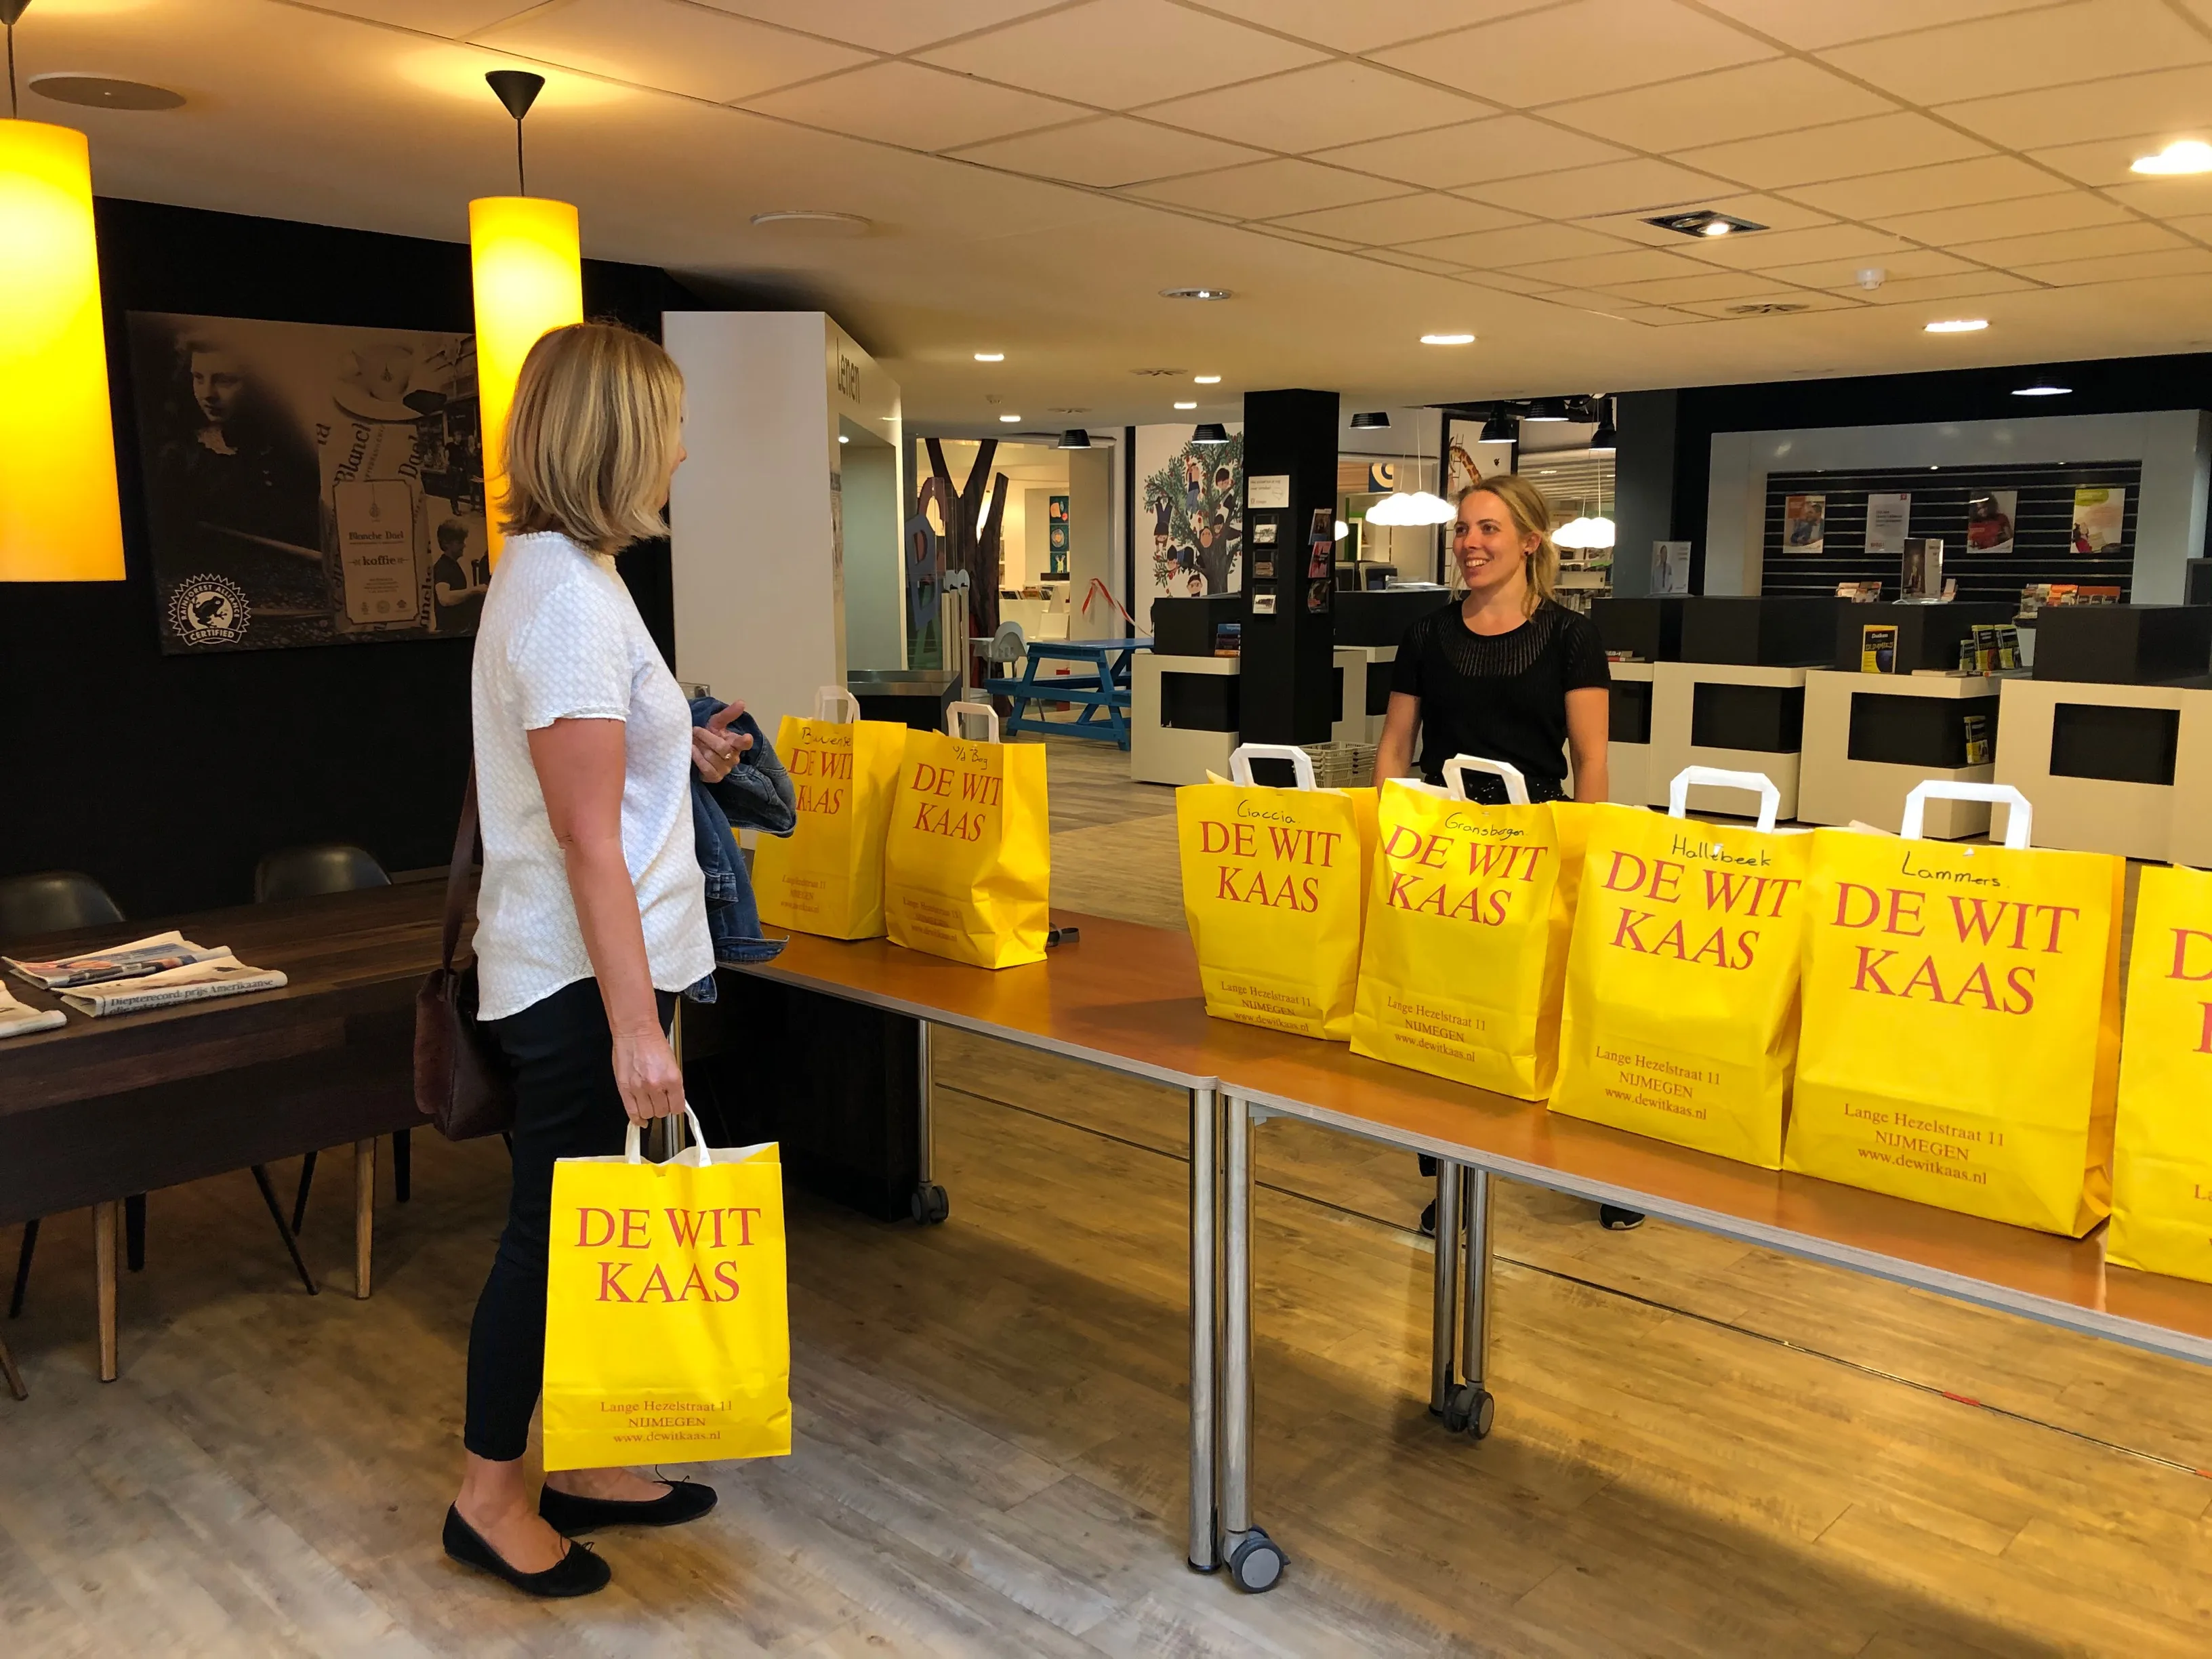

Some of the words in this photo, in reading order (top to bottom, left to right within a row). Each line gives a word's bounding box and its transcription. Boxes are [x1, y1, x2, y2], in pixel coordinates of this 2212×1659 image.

[836, 337, 860, 405] Lenen
[334, 422, 372, 483] Blanc
[363, 555, 396, 566] koffie
[180, 584, 212, 620] RAINFOREST
[216, 586, 240, 618] ALLIANCE
[190, 629, 234, 640] CERTIFIED
[788, 747, 816, 776] DE
[910, 762, 955, 797] DE
[962, 773, 1003, 806] WIT
[913, 802, 987, 842] KAAS
[1198, 821, 1258, 858] DE
[1267, 826, 1342, 868] WIT
[1385, 823, 1454, 869] DE
[1469, 842, 1549, 882] WIT
[1215, 865, 1319, 914] KAAS
[1386, 871, 1512, 927] KAAS
[1601, 851, 1685, 903] DE
[1702, 869, 1802, 918] WIT
[1830, 881, 1927, 938] DE
[1948, 895, 2080, 954] WIT
[1609, 907, 1760, 970] KAAS
[184, 986, 209, 999] prijs
[211, 978, 274, 994] Amerikaanse
[1221, 981, 1248, 996] Lange
[1249, 985, 1300, 1006] Hezelstraat
[1301, 998, 1311, 1007] 11
[1849, 945, 2036, 1015] KAAS
[1242, 1000, 1296, 1017] NIJMEGEN
[1387, 996, 1413, 1015] Lange
[1416, 1004, 1472, 1027] Hezelstraat
[1475, 1019, 1486, 1031] 11
[1394, 1031, 1475, 1063] www.dewitkaas.nl
[1404, 1019, 1465, 1043] NIJMEGEN
[1595, 1046, 1632, 1067] Lange
[1635, 1053, 1703, 1082] Hezelstraat
[1706, 1071, 1721, 1086] 11
[1618, 1071, 1694, 1100] NIJMEGEN
[1605, 1087, 1707, 1121] www.dewitkaas.nl
[1843, 1103, 1889, 1127] Lange
[1894, 1111, 1982, 1143] Hezelstraat
[1988, 1130, 2005, 1147] 11
[1875, 1130, 1969, 1162] NIJMEGEN
[1858, 1147, 1988, 1186] www.dewitkaas.nl
[574, 1207, 652, 1250] DE
[664, 1207, 762, 1250] WIT
[595, 1261, 740, 1303] KAAS
[600, 1400, 640, 1415] Lange
[643, 1400, 716, 1412] Hezelstraat
[719, 1401, 733, 1411] 11
[628, 1417, 706, 1429] NIJMEGEN
[613, 1431, 721, 1443] www.dewitkaas.nl
